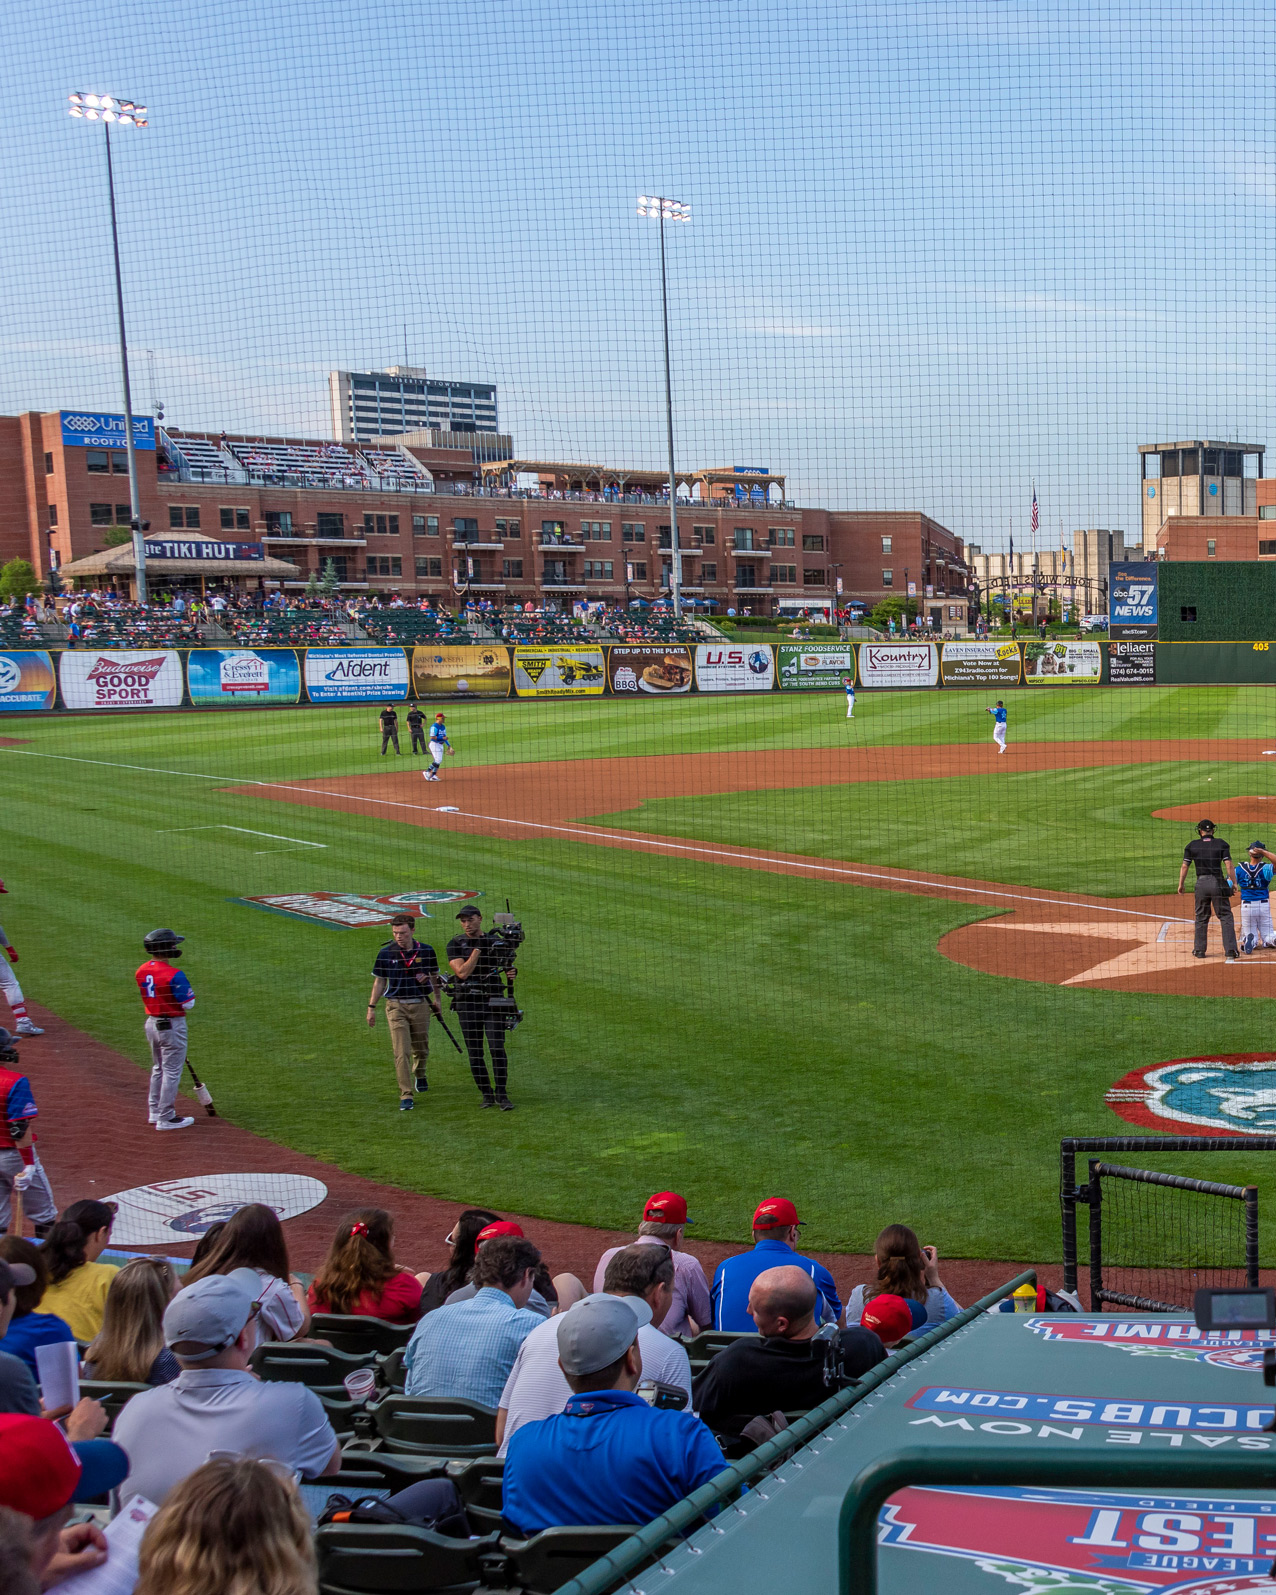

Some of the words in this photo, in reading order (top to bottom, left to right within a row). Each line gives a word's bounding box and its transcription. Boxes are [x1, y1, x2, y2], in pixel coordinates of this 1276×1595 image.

[390, 377, 423, 385] LIBERTY
[101, 417, 148, 432] Unied
[163, 543, 197, 558] TIKI
[202, 544, 236, 558] HUT
[1127, 585, 1154, 605] 57
[1114, 606, 1154, 616] NEWS
[996, 646, 1018, 658] Rocks
[1054, 644, 1067, 655] 811
[1116, 642, 1154, 655] Leliaert
[1252, 643, 1270, 651] 405
[706, 651, 745, 664] U.S.
[869, 649, 927, 669] Kountry
[223, 663, 252, 672] Cressy
[332, 660, 390, 678] Afdent
[95, 675, 150, 688] GOOD
[615, 680, 637, 690] BBQ
[96, 688, 150, 700] SPORT
[146, 974, 155, 998] 2
[909, 1415, 1086, 1440] NOW
[1106, 1430, 1272, 1449] SALE
[1139, 1498, 1214, 1511] FIELD
[1145, 1553, 1255, 1572] LEAGUE
